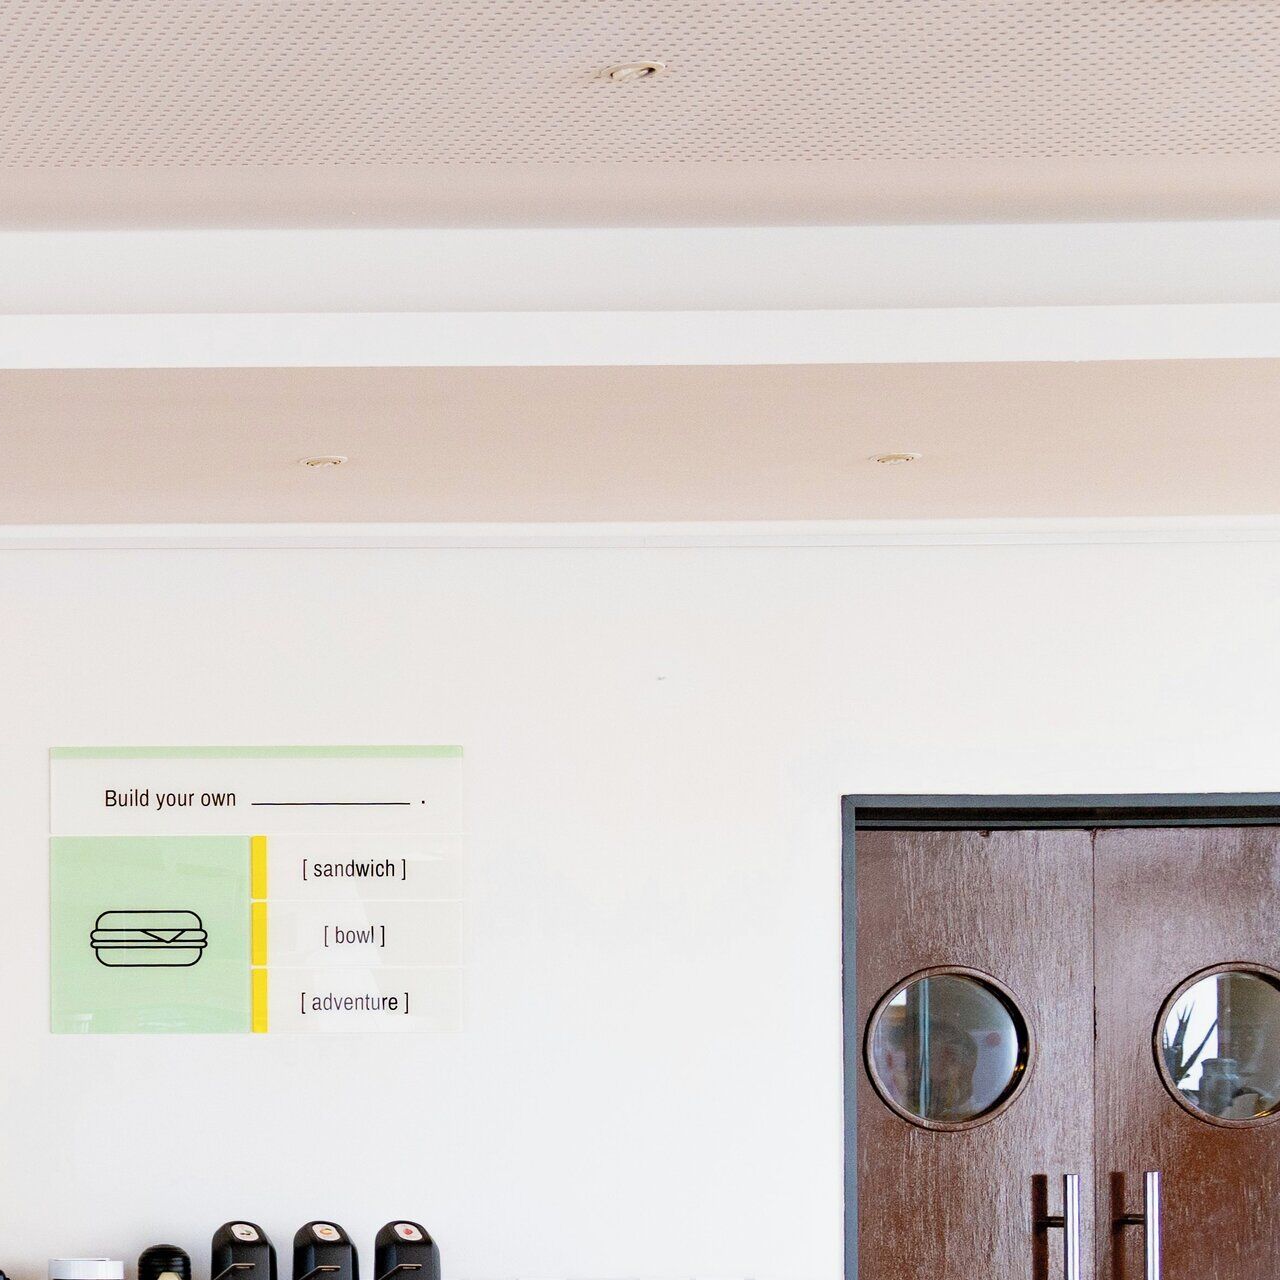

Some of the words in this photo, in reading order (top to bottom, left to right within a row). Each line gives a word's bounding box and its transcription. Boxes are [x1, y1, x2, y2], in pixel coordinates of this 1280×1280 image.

[105, 789, 150, 807] Build
[156, 793, 195, 811] your
[201, 793, 236, 807] own
[313, 859, 395, 877] sandwich
[335, 925, 375, 945] bowl
[312, 992, 399, 1011] adventure
